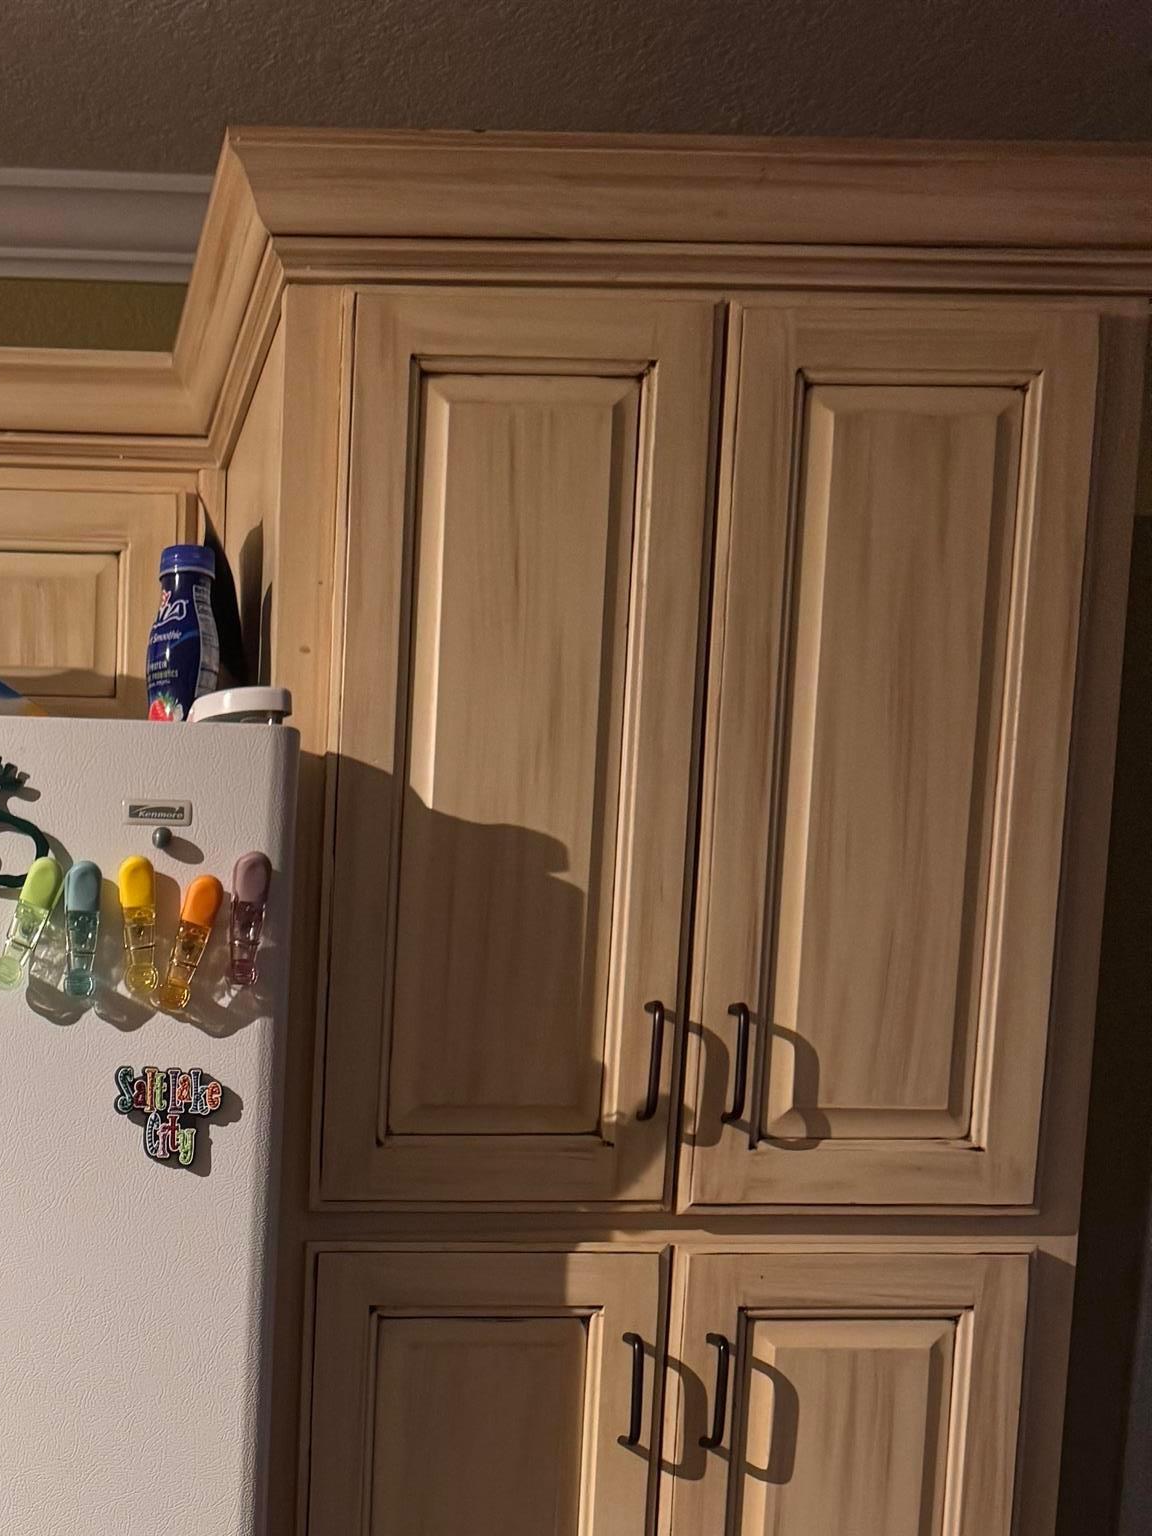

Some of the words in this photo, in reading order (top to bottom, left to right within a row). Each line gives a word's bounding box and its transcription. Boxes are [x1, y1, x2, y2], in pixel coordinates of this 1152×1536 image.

[139, 811, 183, 819] Kenmore
[117, 1067, 167, 1113] Salt
[167, 1068, 222, 1115] Lake
[146, 1111, 197, 1165] City
